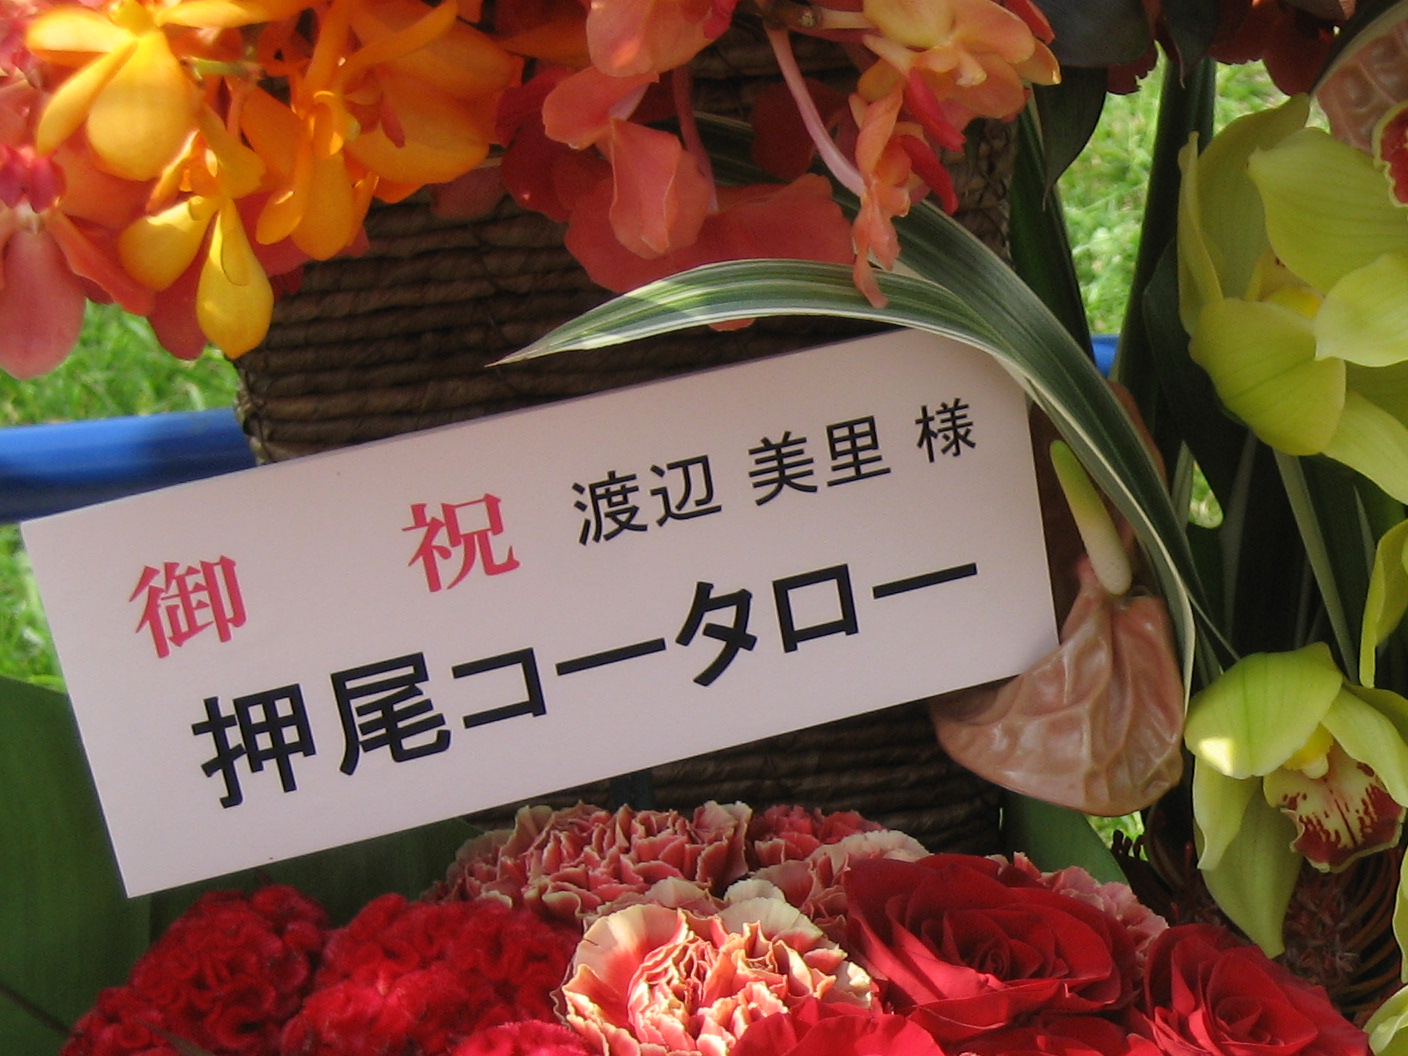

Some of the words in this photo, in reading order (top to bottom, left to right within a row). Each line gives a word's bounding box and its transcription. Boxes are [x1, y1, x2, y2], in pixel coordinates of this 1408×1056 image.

[570, 454, 723, 547] 渡辺
[747, 414, 892, 507] 美里
[914, 397, 977, 464] 様
[127, 554, 248, 660] 御
[401, 492, 522, 594] 祝
[190, 561, 979, 810] 押尾コータロー
